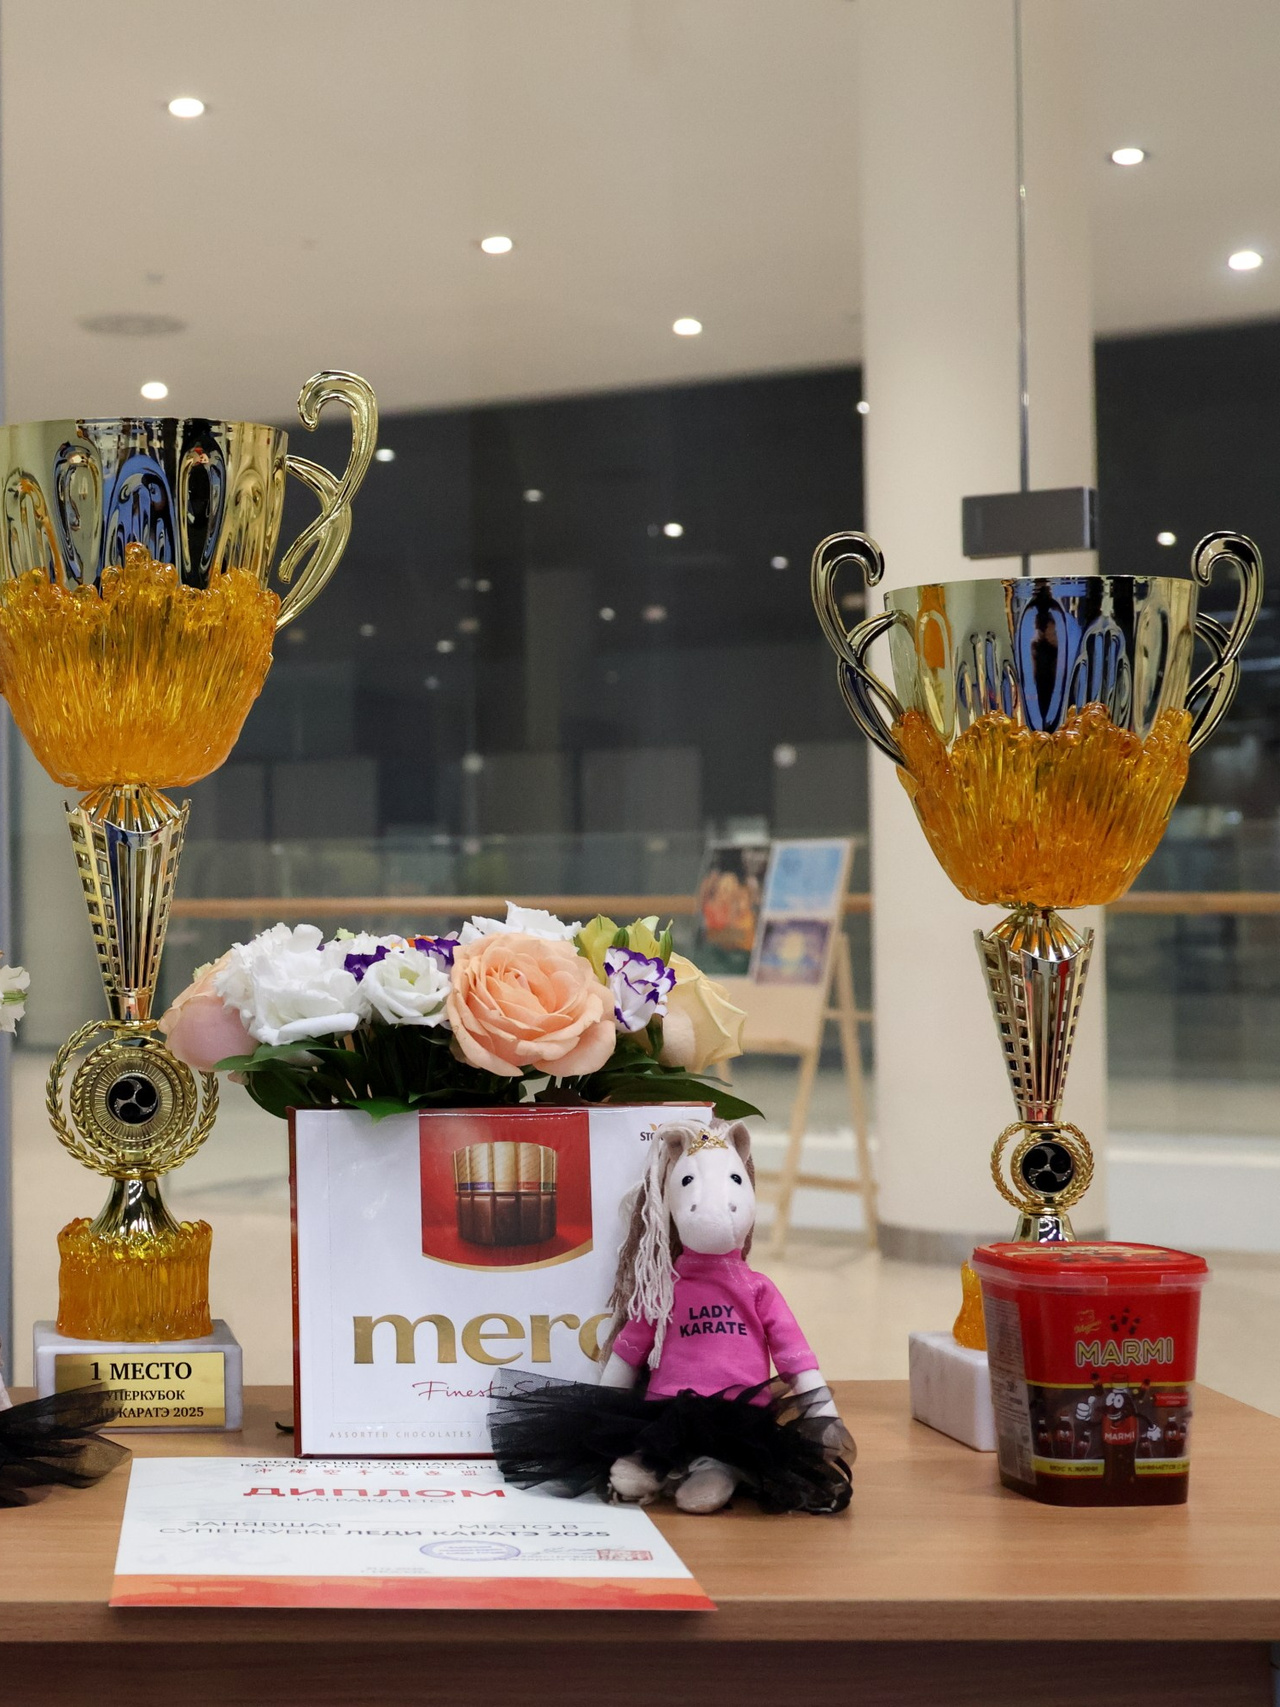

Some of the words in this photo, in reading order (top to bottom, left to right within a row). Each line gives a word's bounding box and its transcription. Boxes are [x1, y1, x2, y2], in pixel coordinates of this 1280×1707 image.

[688, 1304, 735, 1321] LADY
[679, 1321, 748, 1338] KARATE
[352, 1313, 613, 1365] merc
[1075, 1336, 1174, 1367] MARMI
[90, 1362, 102, 1380] 1
[109, 1361, 192, 1381] МЕСТО
[106, 1390, 185, 1401] УПЕРКУБОК
[412, 1381, 506, 1400] Finest
[119, 1407, 170, 1418] КАРАТЭ
[173, 1406, 204, 1418] 2025
[329, 1431, 389, 1439] ASSORTED
[1104, 1431, 1135, 1442] MARMI
[243, 1487, 506, 1498] ДИПЛОМ
[159, 1527, 338, 1535] СУПЕРКУБКЕ
